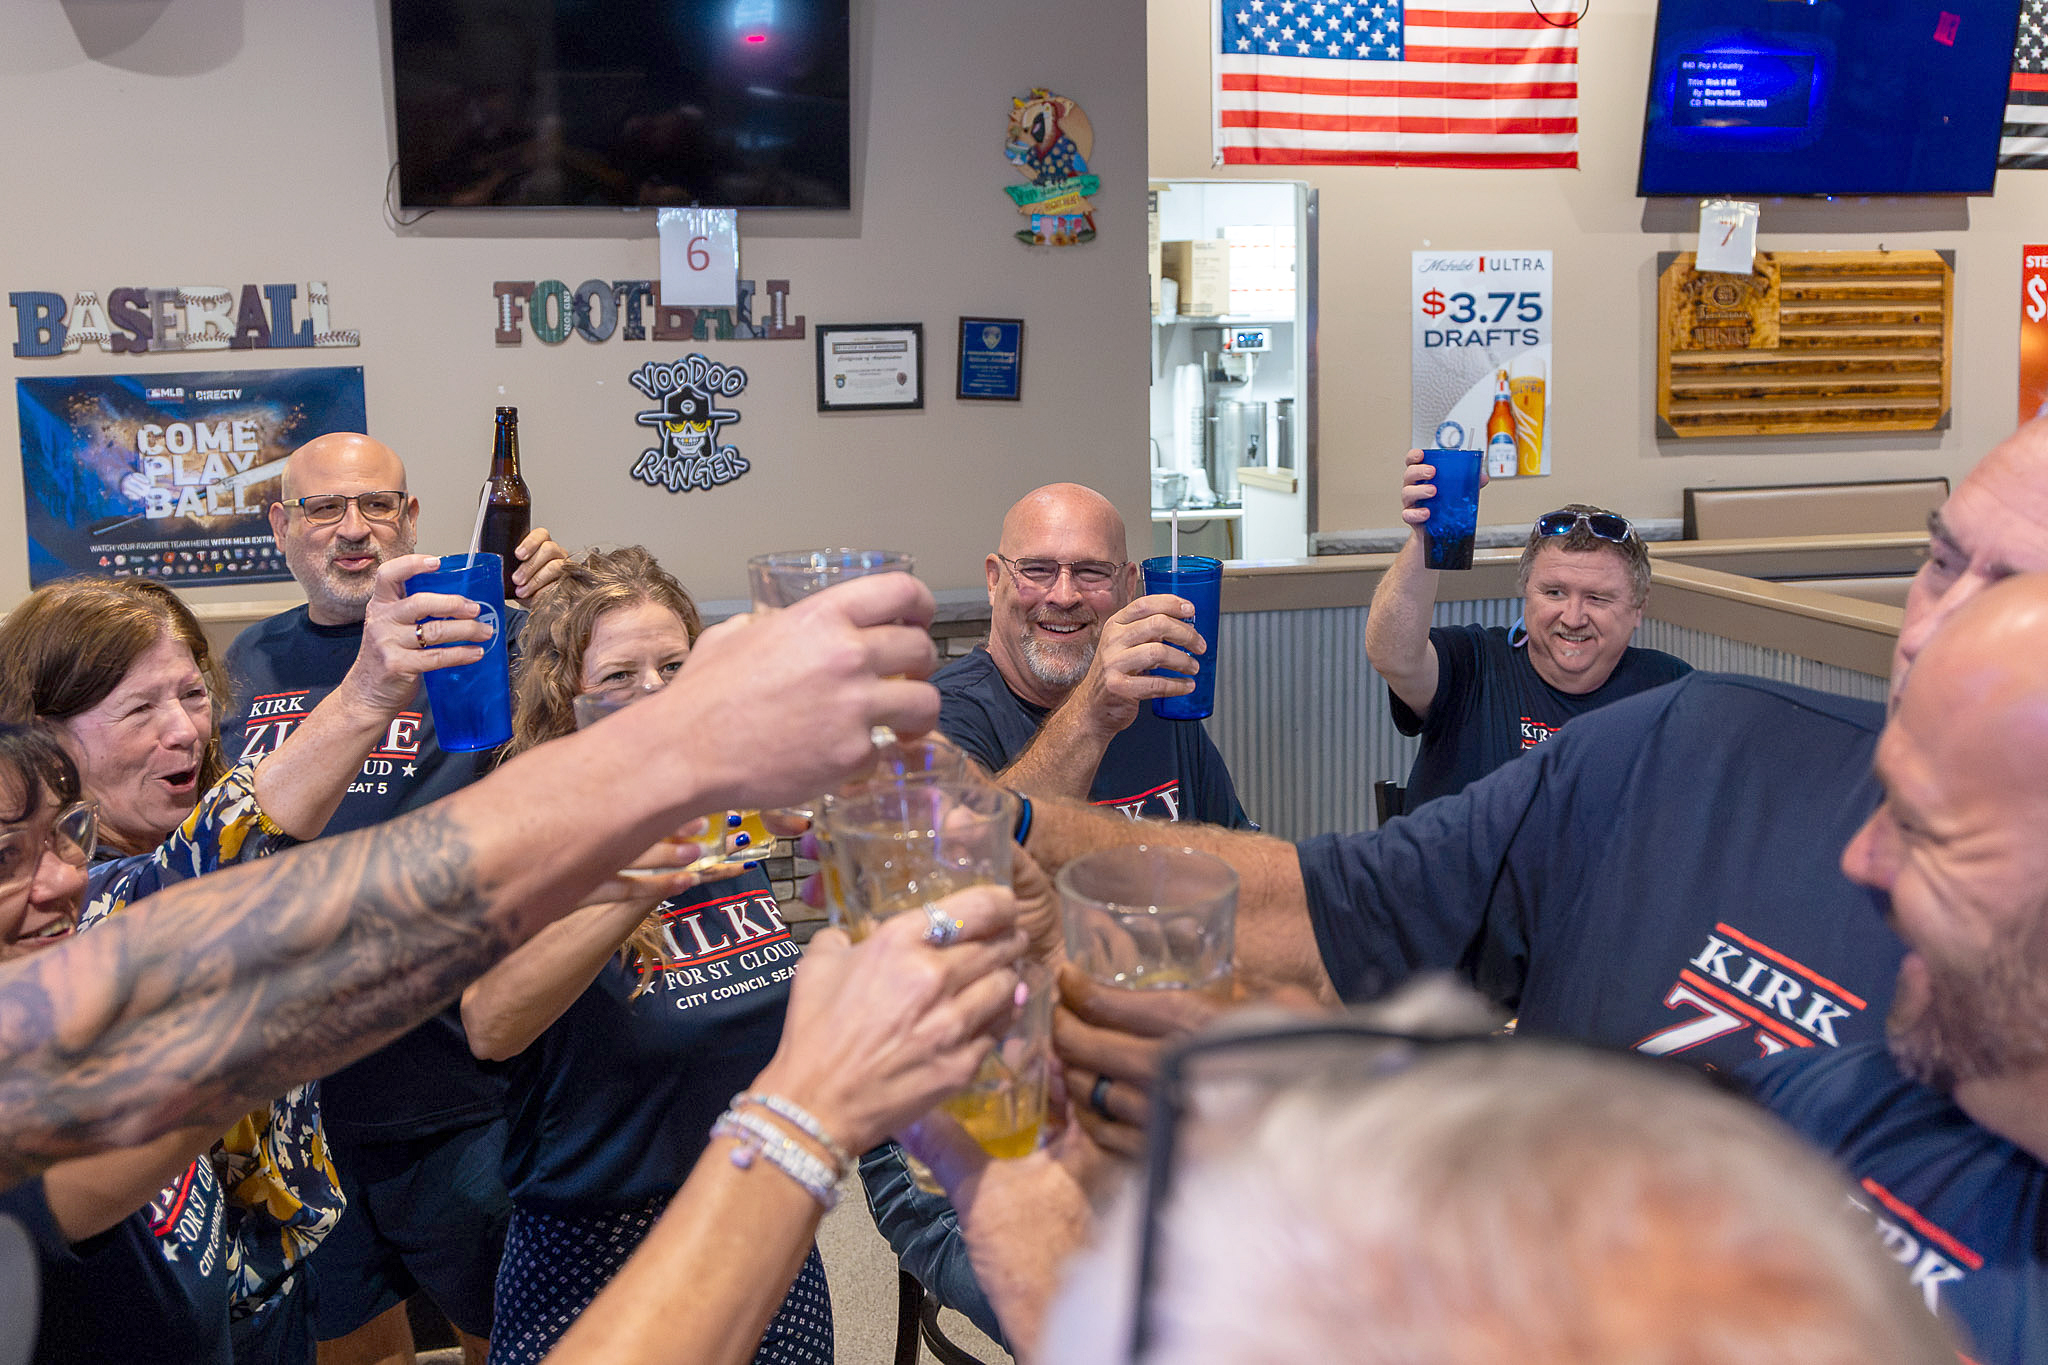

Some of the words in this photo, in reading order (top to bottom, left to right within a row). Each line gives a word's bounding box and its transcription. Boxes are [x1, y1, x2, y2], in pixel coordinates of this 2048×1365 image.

[1719, 220, 1737, 247] 7
[686, 236, 710, 272] 6
[1490, 258, 1545, 271] ULTRA
[9, 281, 360, 358] BASEBALL
[1422, 287, 1543, 323] $3.75
[1425, 328, 1540, 348] DRAFTS
[631, 355, 747, 396] VOODOO
[161, 388, 184, 397] MLB
[196, 389, 242, 400] DIRECTV
[137, 420, 258, 455] COME
[144, 452, 256, 486] PLAY
[632, 448, 749, 491] RANGER
[145, 479, 260, 519] BALL
[90, 543, 115, 552] WATCH
[211, 538, 231, 546] WITH
[248, 696, 304, 718] KIRK
[240, 717, 422, 759] ZIE
[1520, 723, 1553, 742] KIR
[377, 782, 388, 794] 5
[664, 967, 709, 991] FOR
[707, 960, 734, 980] ST
[739, 940, 800, 971] CLOUD
[675, 992, 708, 1010] CITY
[711, 975, 770, 1001] COUNCIL
[1689, 935, 1851, 1048] KIRK
[190, 1185, 207, 1218] ST
[199, 1242, 217, 1277] CITY
